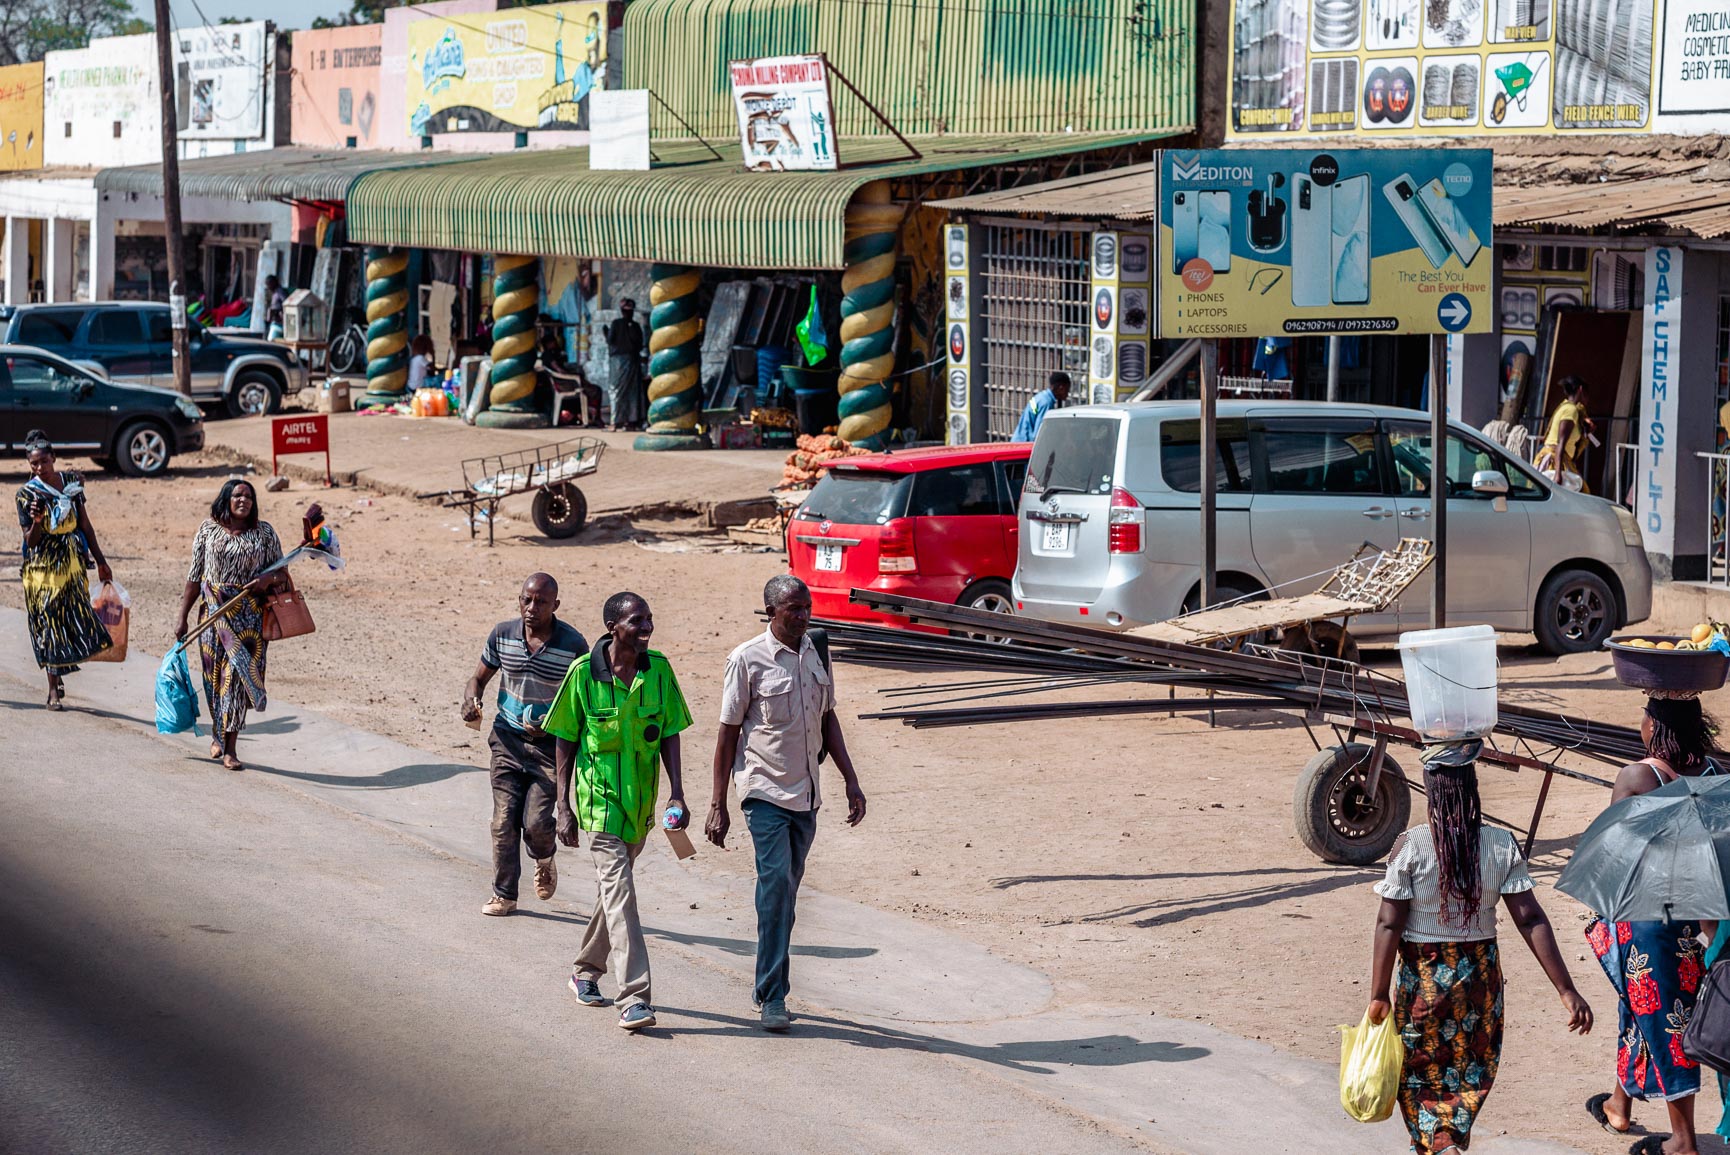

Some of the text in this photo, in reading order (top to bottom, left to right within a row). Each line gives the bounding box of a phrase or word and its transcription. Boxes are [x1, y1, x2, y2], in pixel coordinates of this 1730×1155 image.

[1685, 12, 1730, 33] MEDICIN
[487, 24, 526, 50] UNITED
[1683, 36, 1730, 57] COSMETIC
[333, 46, 382, 68] ENTERPRISES
[755, 65, 779, 85] MILLING
[780, 63, 810, 84] COMPANY
[810, 61, 822, 81] LTD
[1680, 61, 1730, 81] BABY PR
[771, 97, 797, 111] DEPOT
[1563, 104, 1641, 122] FIELD FENCE WIRE
[1172, 162, 1253, 181] MEDITON
[1399, 271, 1464, 282] The Best You
[1417, 282, 1486, 293] Can Ever Have
[1187, 293, 1224, 302] PHONES
[1187, 308, 1227, 317] LAPTOPS
[1187, 324, 1247, 334] ACCESSORIES
[1647, 248, 1671, 534] SAF CHEMIST LTD
[281, 421, 318, 436] AIRTEL
